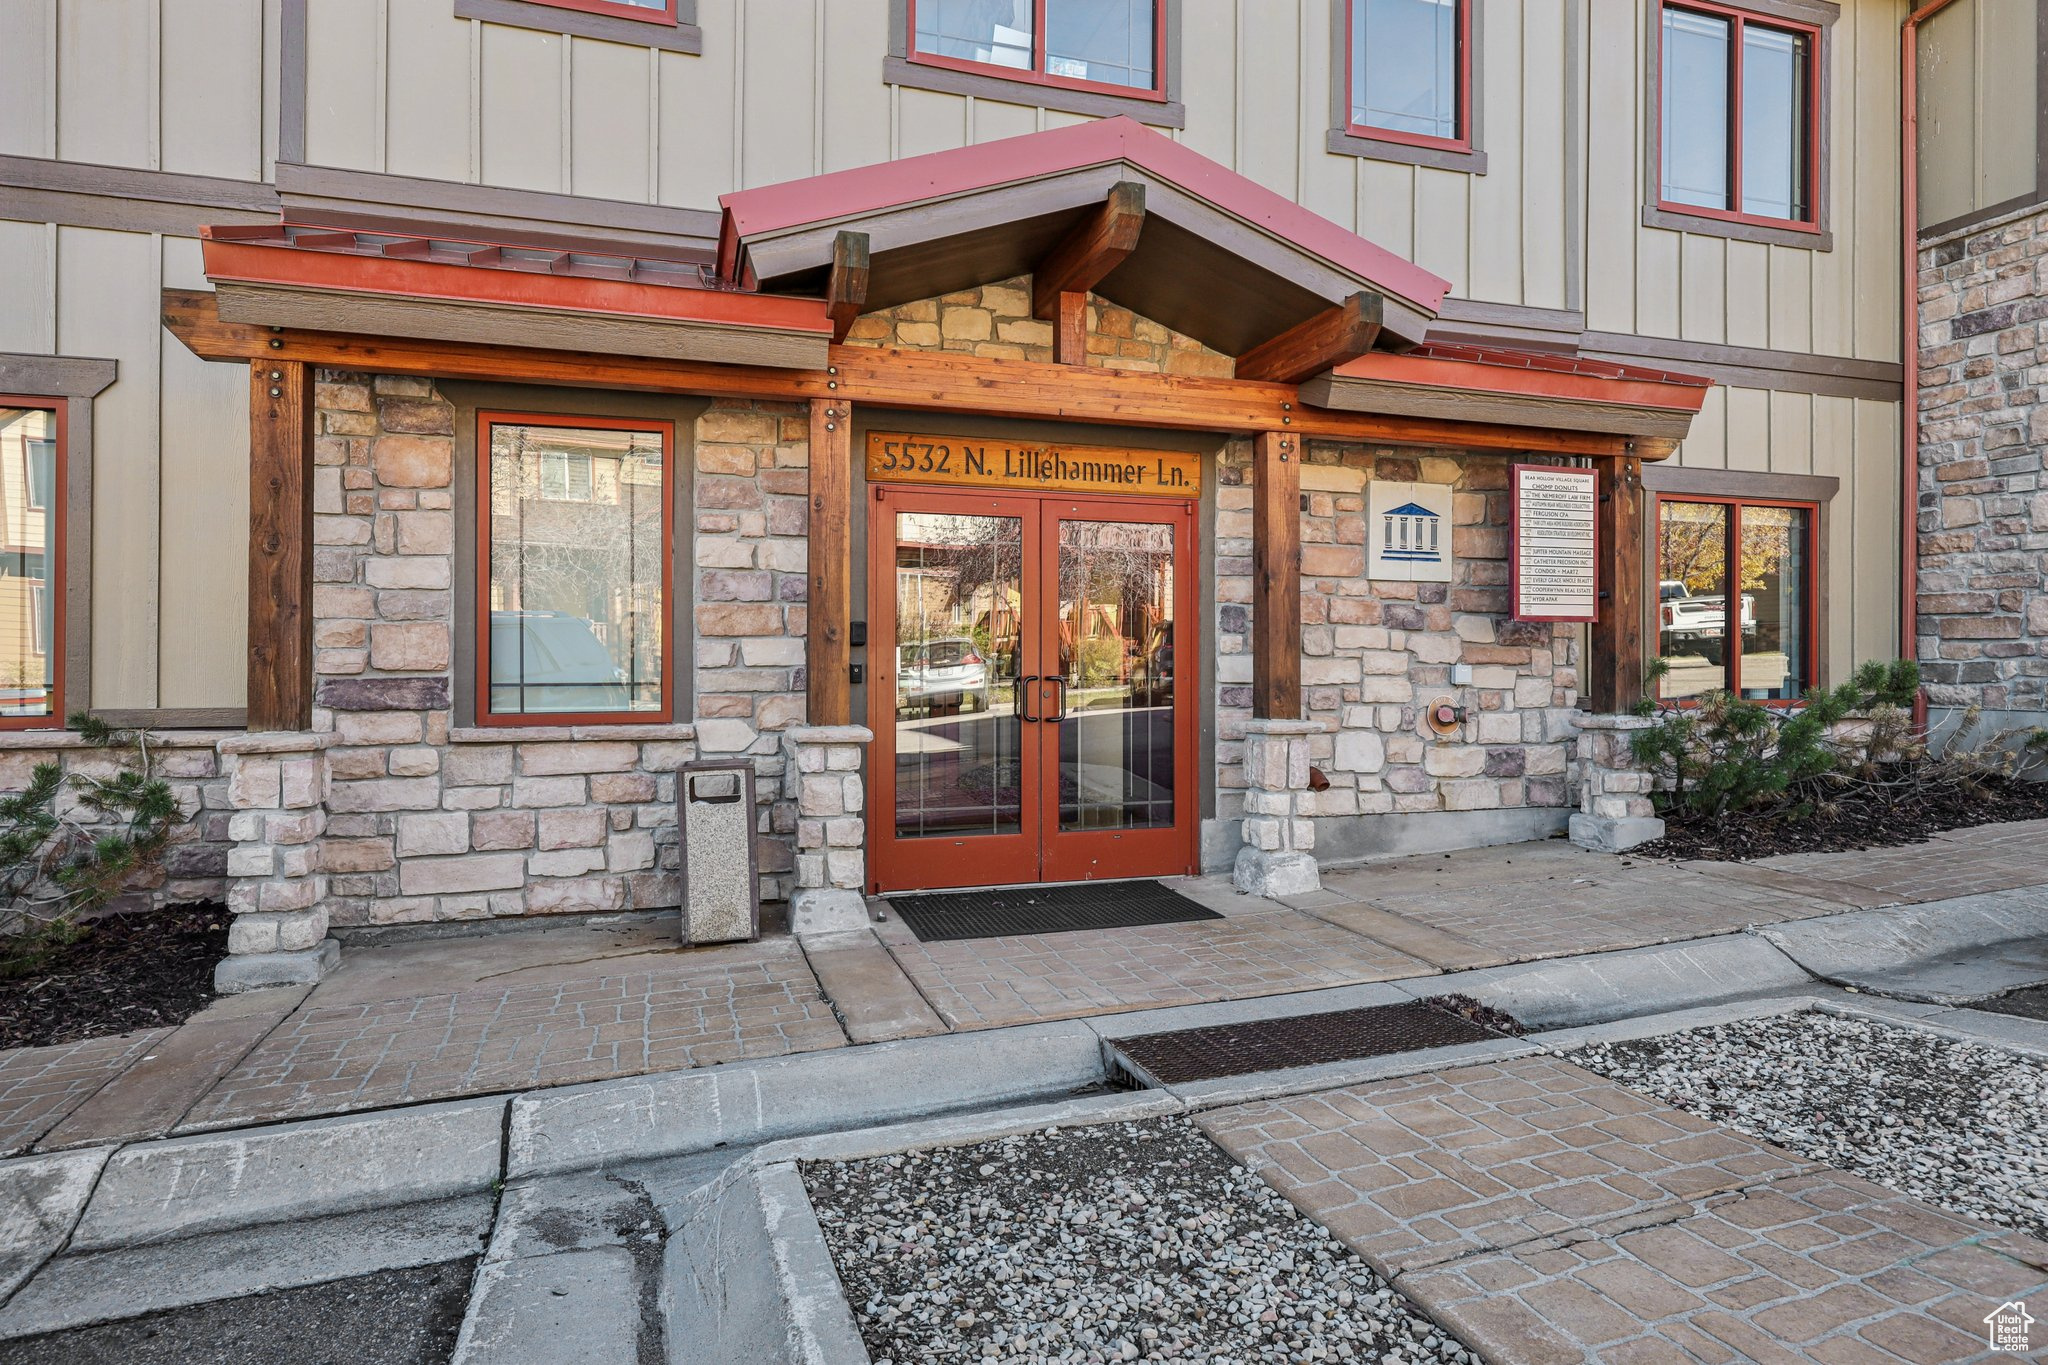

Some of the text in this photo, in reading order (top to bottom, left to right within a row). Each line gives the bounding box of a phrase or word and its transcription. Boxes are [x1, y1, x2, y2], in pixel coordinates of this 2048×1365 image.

[882, 442, 1190, 487] 5532 N. Lillehammer Ln.
